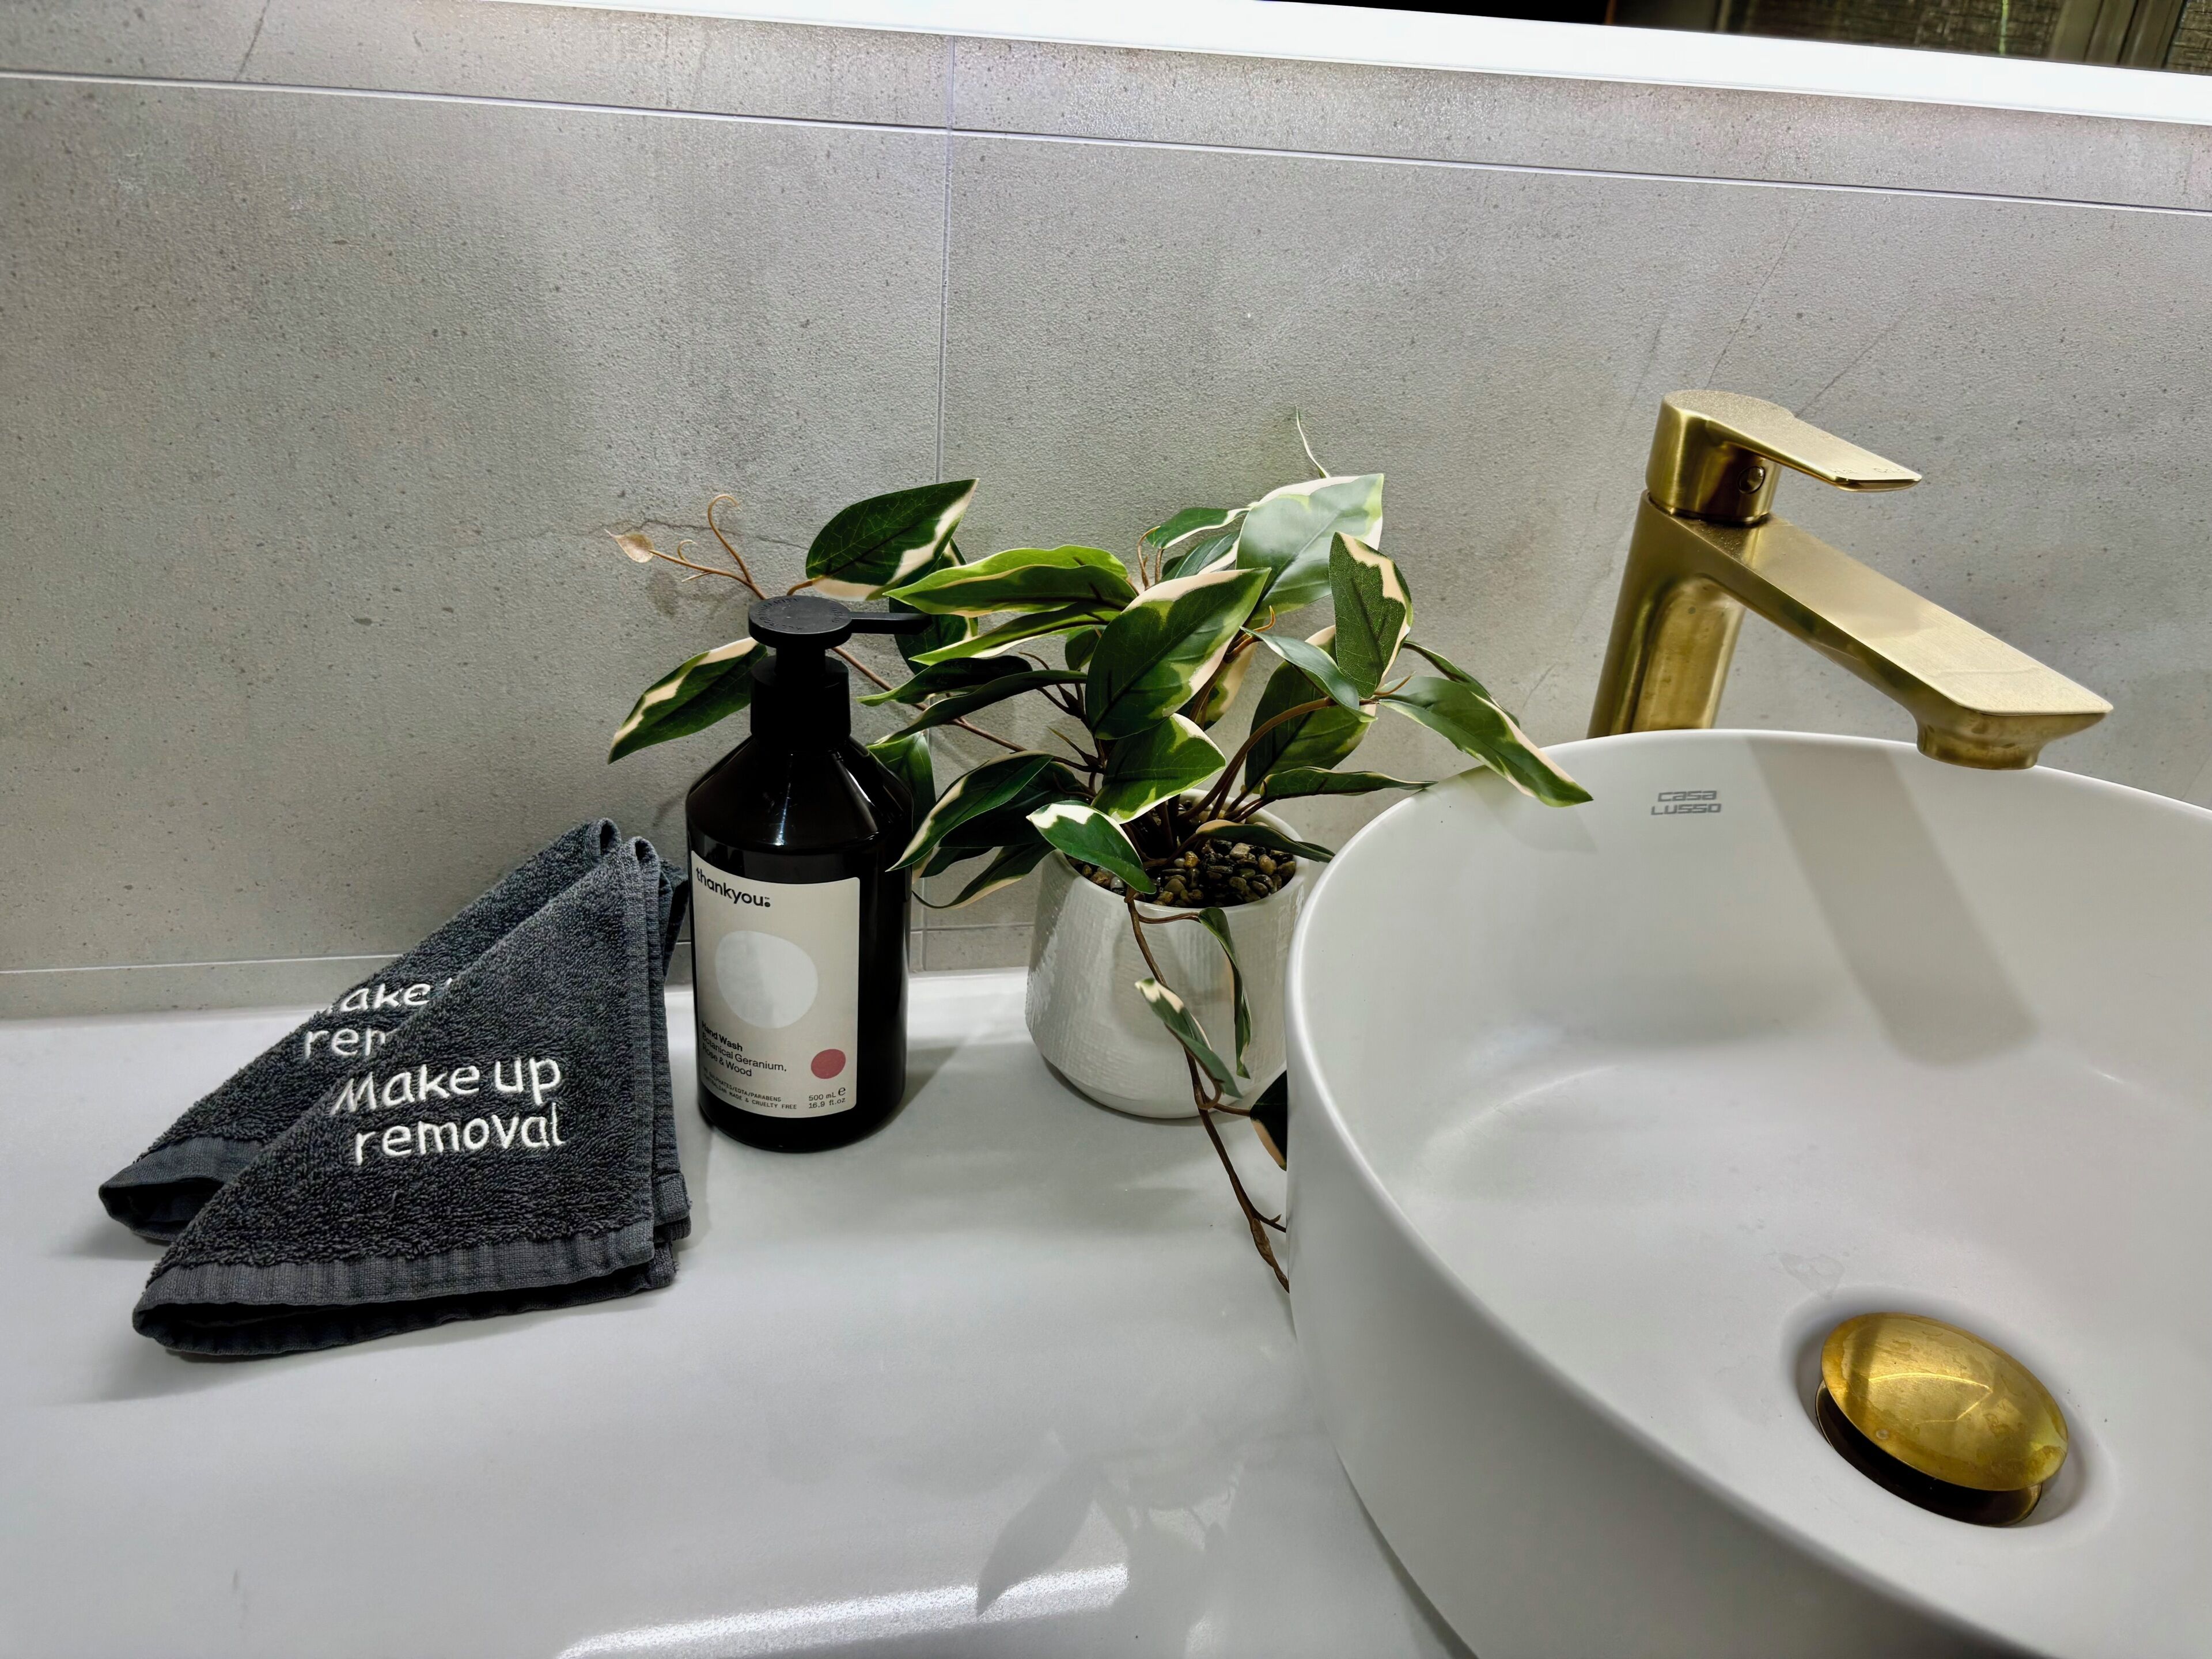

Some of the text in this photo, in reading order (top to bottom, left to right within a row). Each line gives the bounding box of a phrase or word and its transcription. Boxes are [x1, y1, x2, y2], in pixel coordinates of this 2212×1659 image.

[326, 982, 432, 1014] ake
[702, 1020, 743, 1052] Hand Wash
[702, 1032, 787, 1072] Botanical Geranium.
[702, 1042, 752, 1077] Rose & Wood
[328, 1056, 561, 1116] Make up
[752, 1099, 778, 1108] CRUELTY
[808, 1101, 825, 1109] 16.9
[354, 1102, 566, 1166] removal
